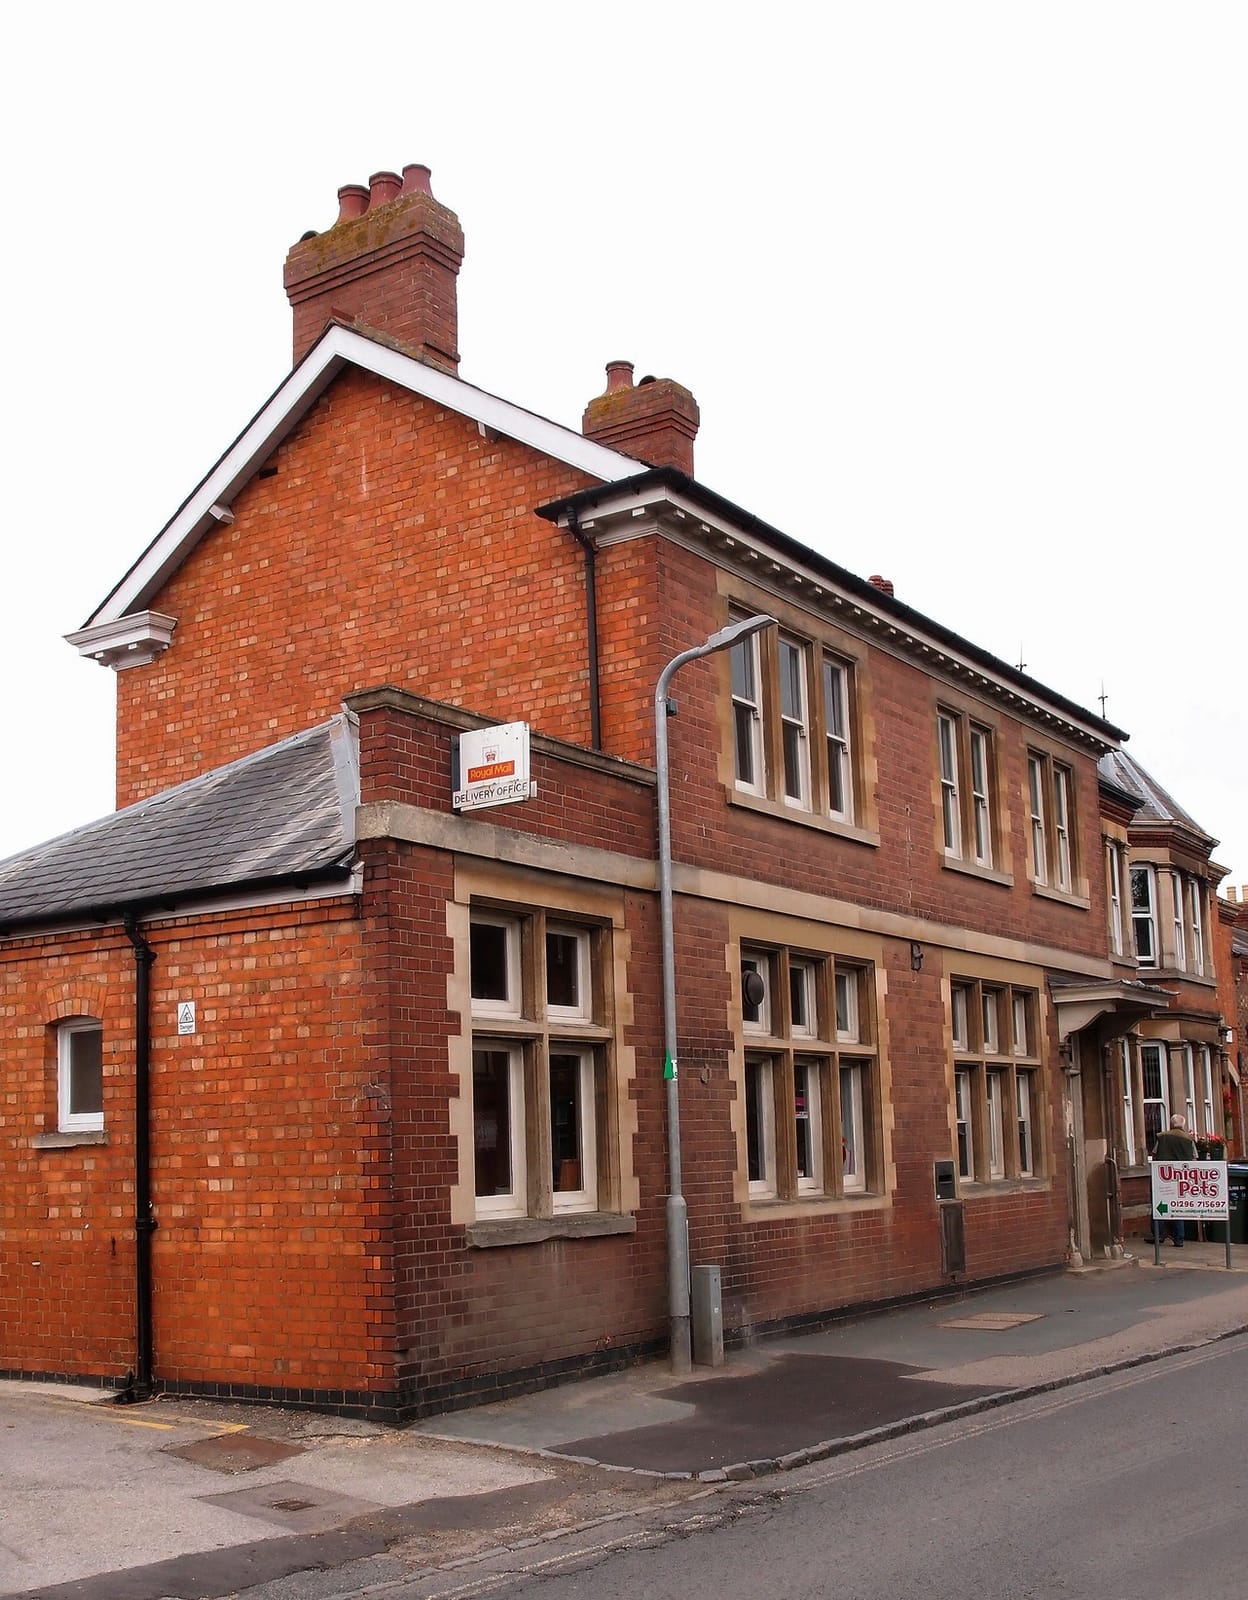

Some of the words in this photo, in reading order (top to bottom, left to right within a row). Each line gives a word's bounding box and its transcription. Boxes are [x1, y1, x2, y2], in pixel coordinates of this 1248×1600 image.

[470, 767, 494, 779] Royal
[495, 763, 512, 775] Mail
[454, 789, 495, 804] DELIVERY
[496, 782, 528, 796] OFFICE
[1159, 1164, 1219, 1184] Unique
[1178, 1181, 1218, 1197] Pets
